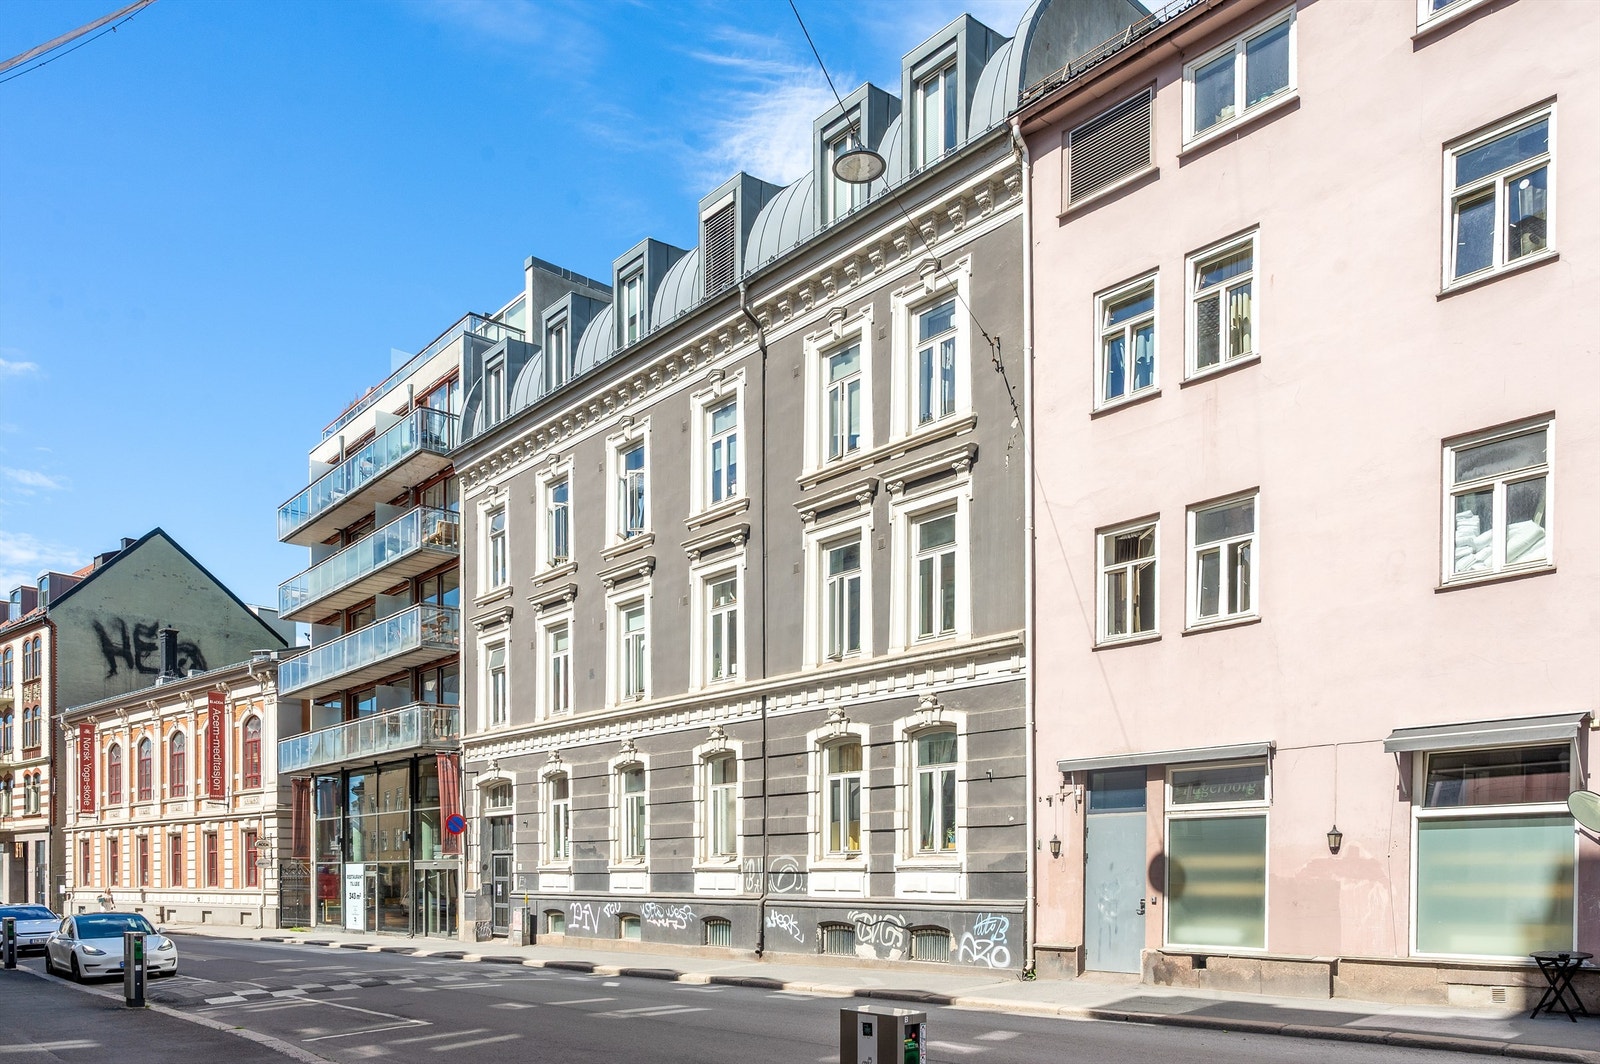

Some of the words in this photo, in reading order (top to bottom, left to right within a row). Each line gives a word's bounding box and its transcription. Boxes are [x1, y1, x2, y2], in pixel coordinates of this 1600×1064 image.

[83, 738, 92, 761] Norsk
[212, 707, 222, 790] Acem-meditasjon
[82, 763, 92, 806] Yoga-skole
